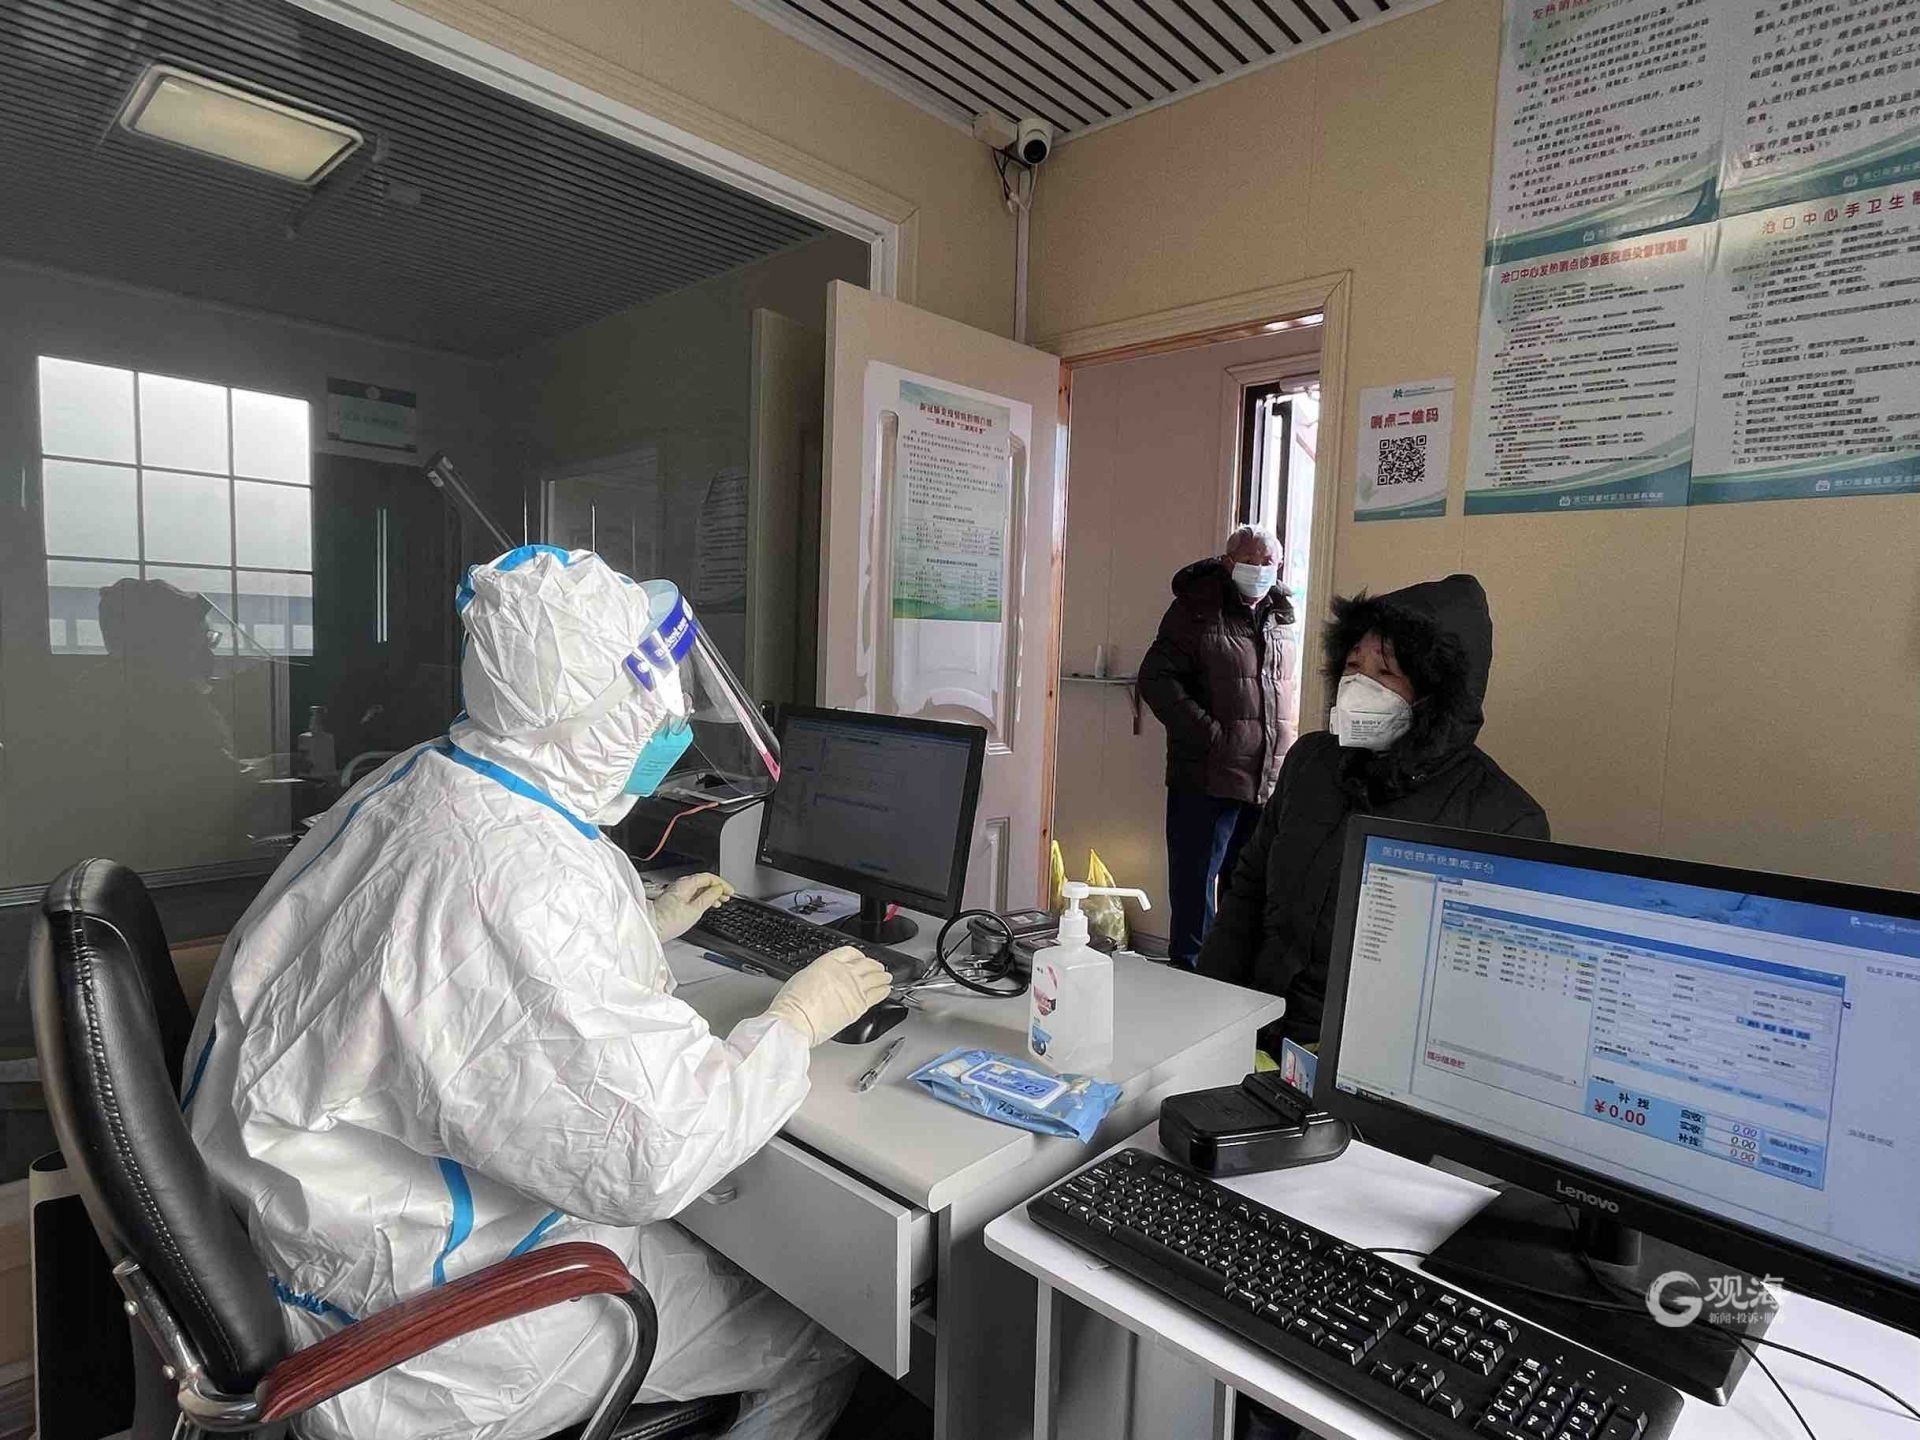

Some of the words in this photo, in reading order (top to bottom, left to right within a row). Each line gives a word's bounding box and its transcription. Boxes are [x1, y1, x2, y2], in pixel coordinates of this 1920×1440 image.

[1370, 407, 1439, 429] 哨点二维码
